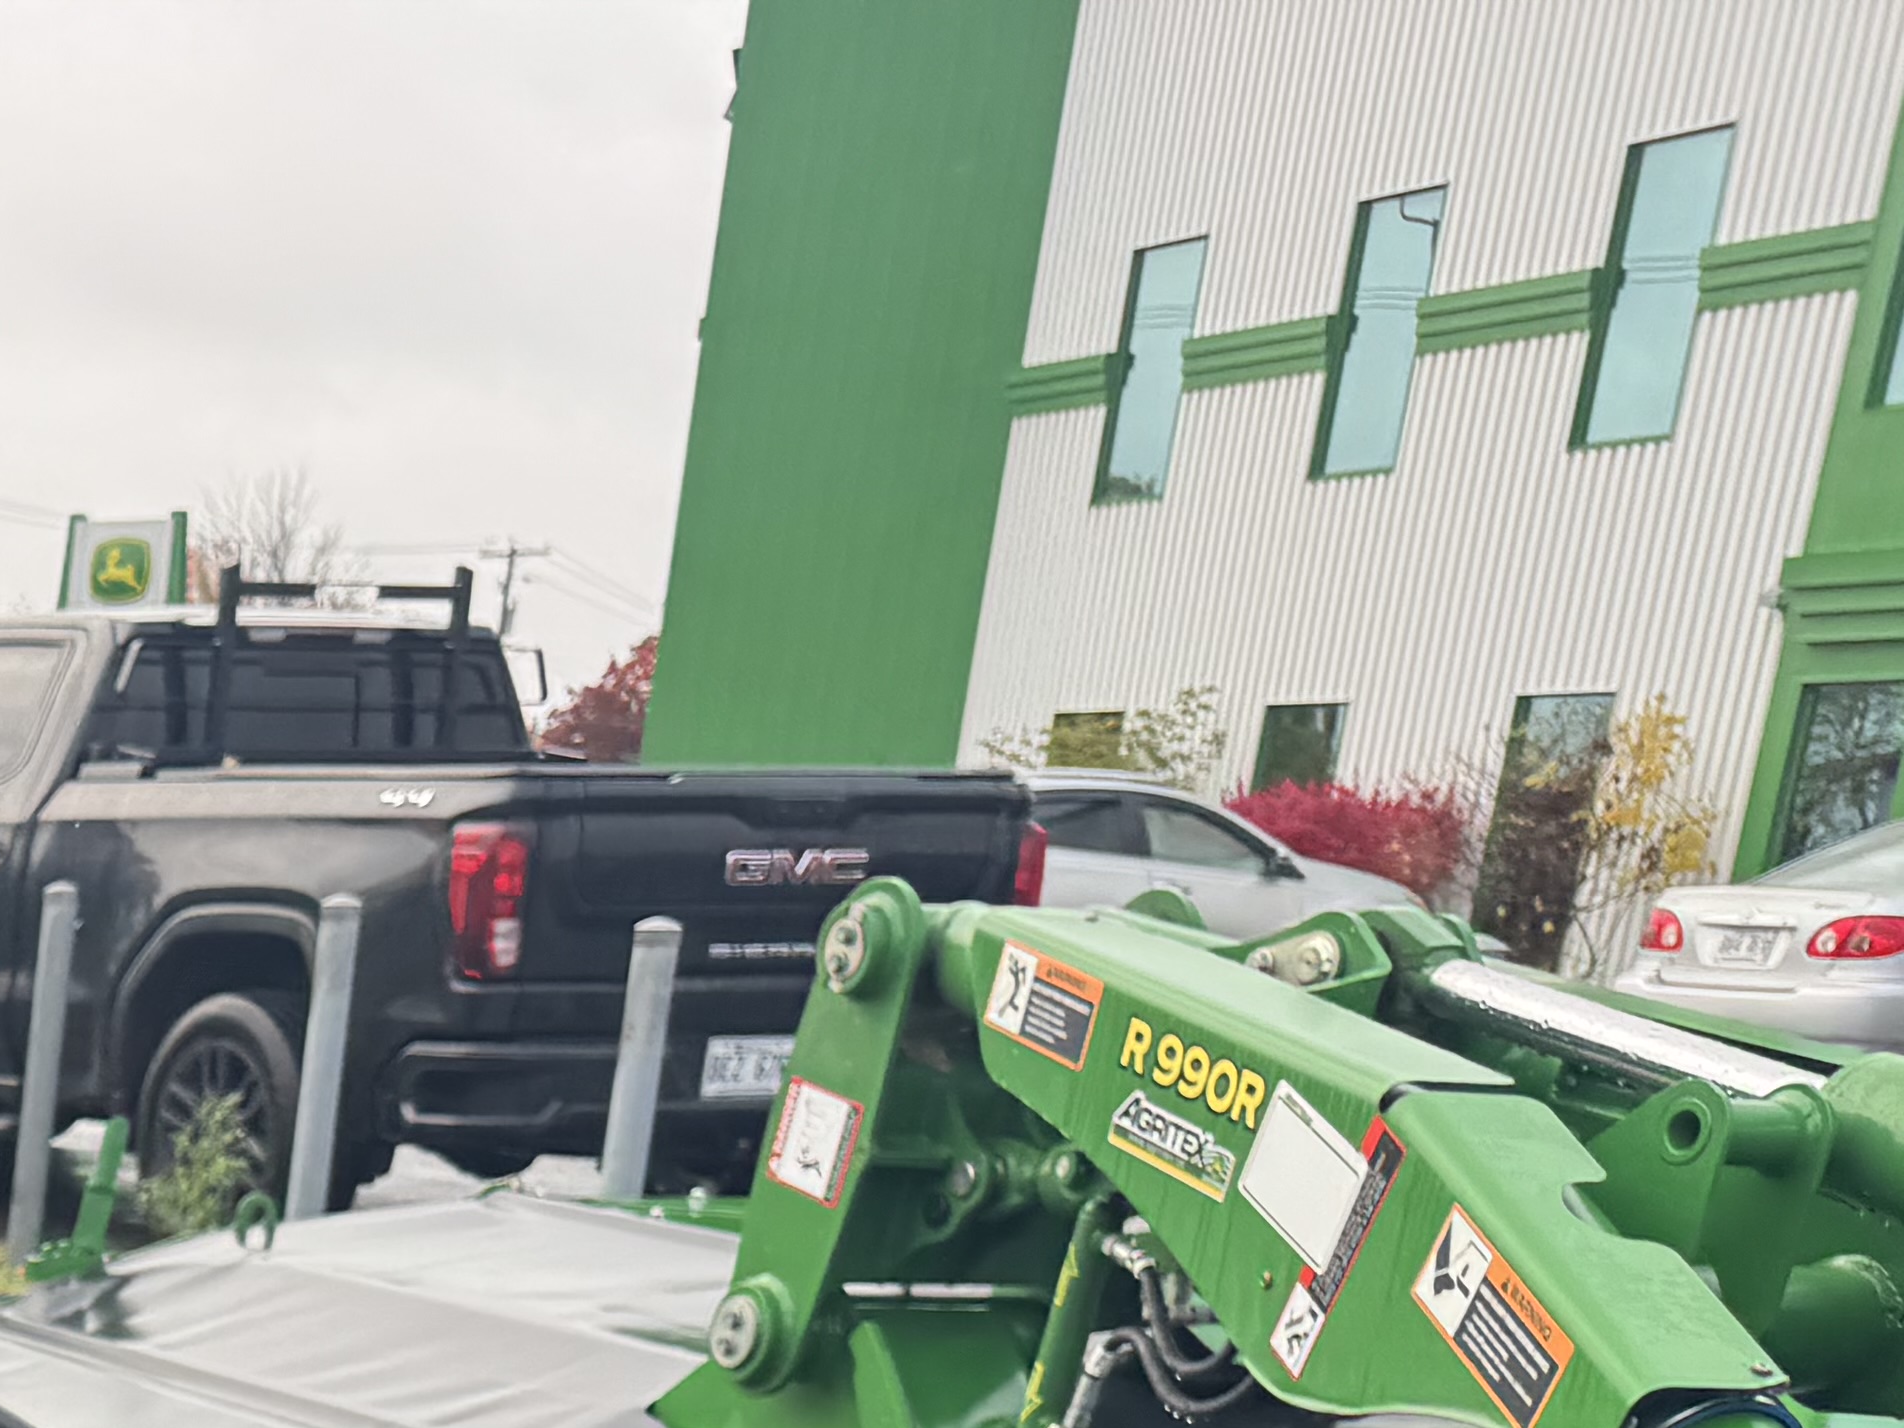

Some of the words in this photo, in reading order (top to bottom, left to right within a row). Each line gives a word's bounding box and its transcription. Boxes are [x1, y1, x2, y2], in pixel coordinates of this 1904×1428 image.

[725, 848, 870, 886] GMC
[1120, 1017, 1153, 1075] R
[1152, 1033, 1265, 1130] 990R
[1118, 1096, 1214, 1170] AGRITEX
